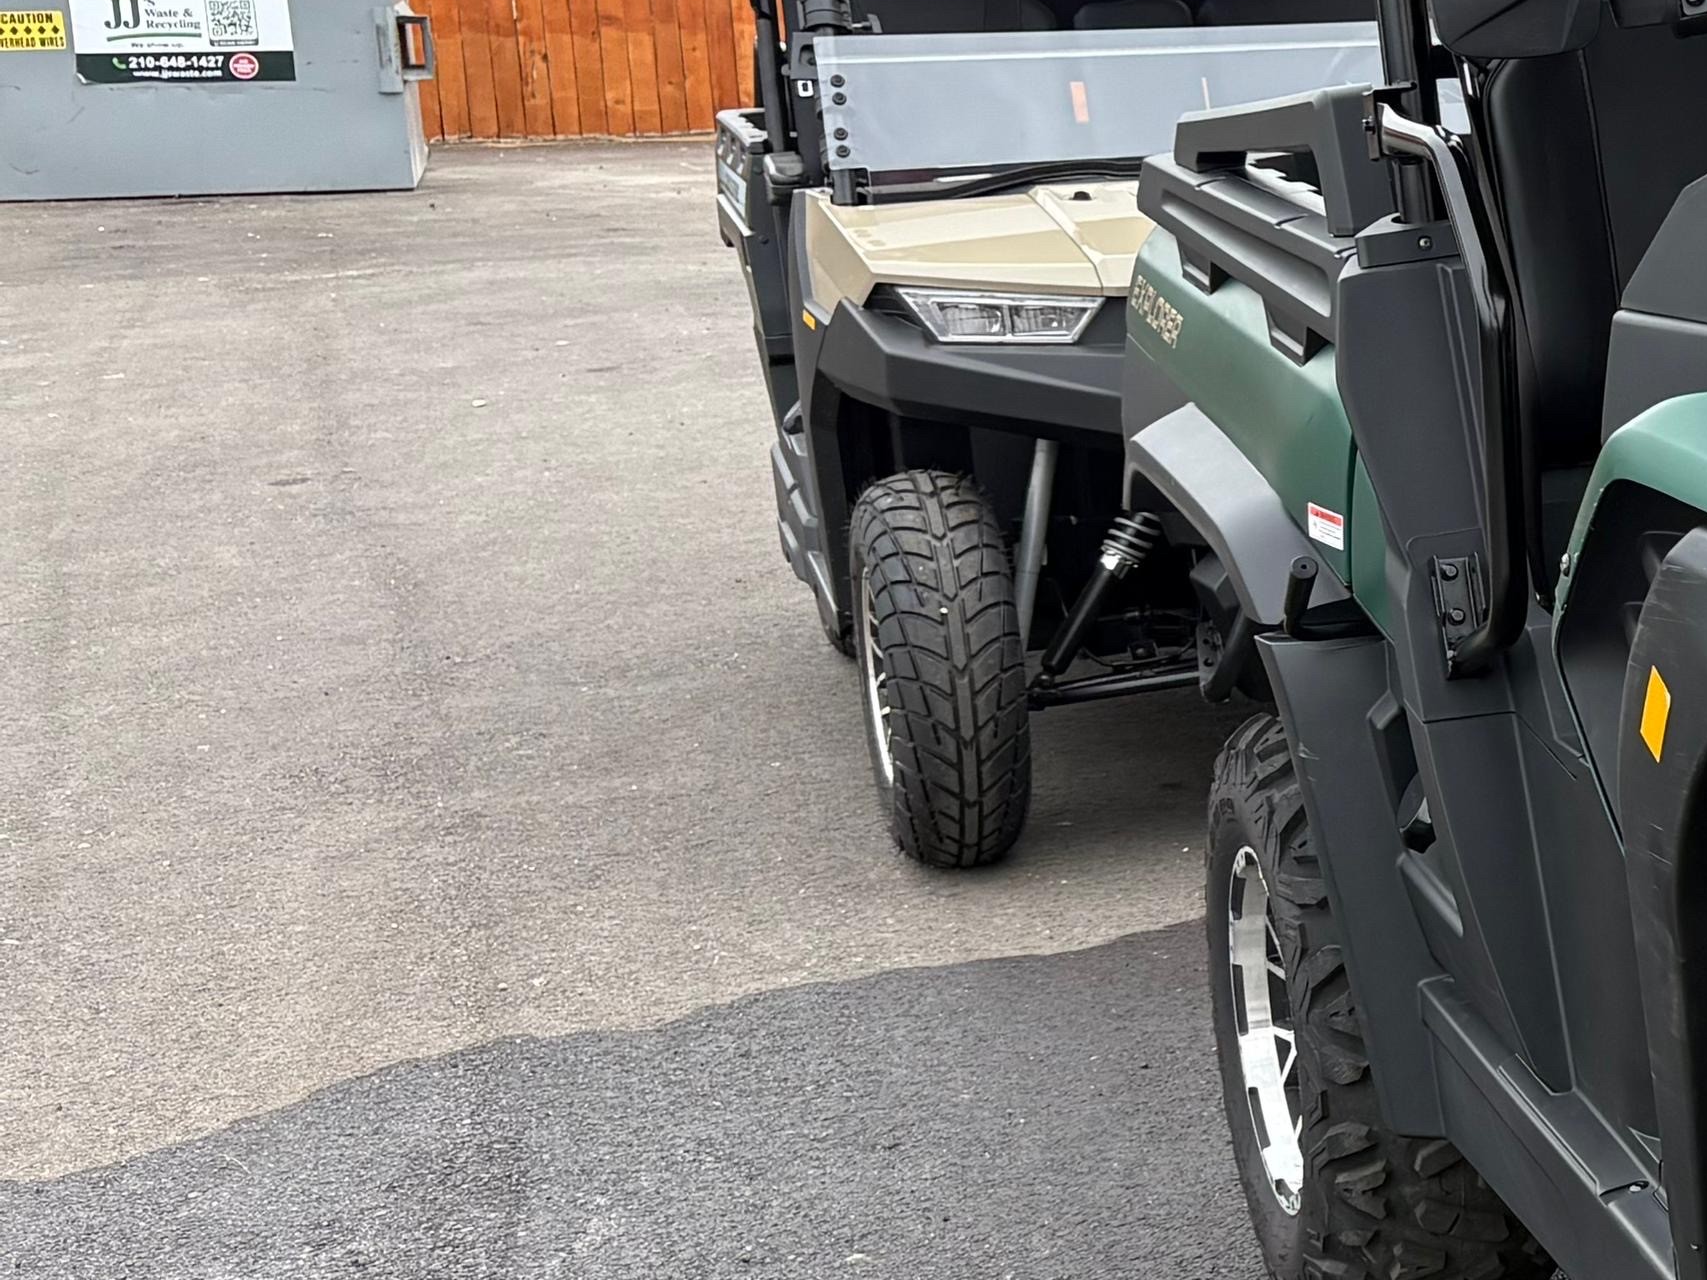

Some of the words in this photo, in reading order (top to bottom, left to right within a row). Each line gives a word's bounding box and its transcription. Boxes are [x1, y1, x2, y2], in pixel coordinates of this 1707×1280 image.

[0, 12, 53, 25] CAUTION
[145, 10, 179, 18] Waste
[183, 8, 193, 17] &
[146, 20, 201, 31] Recycling
[0, 36, 36, 49] VERHEAD
